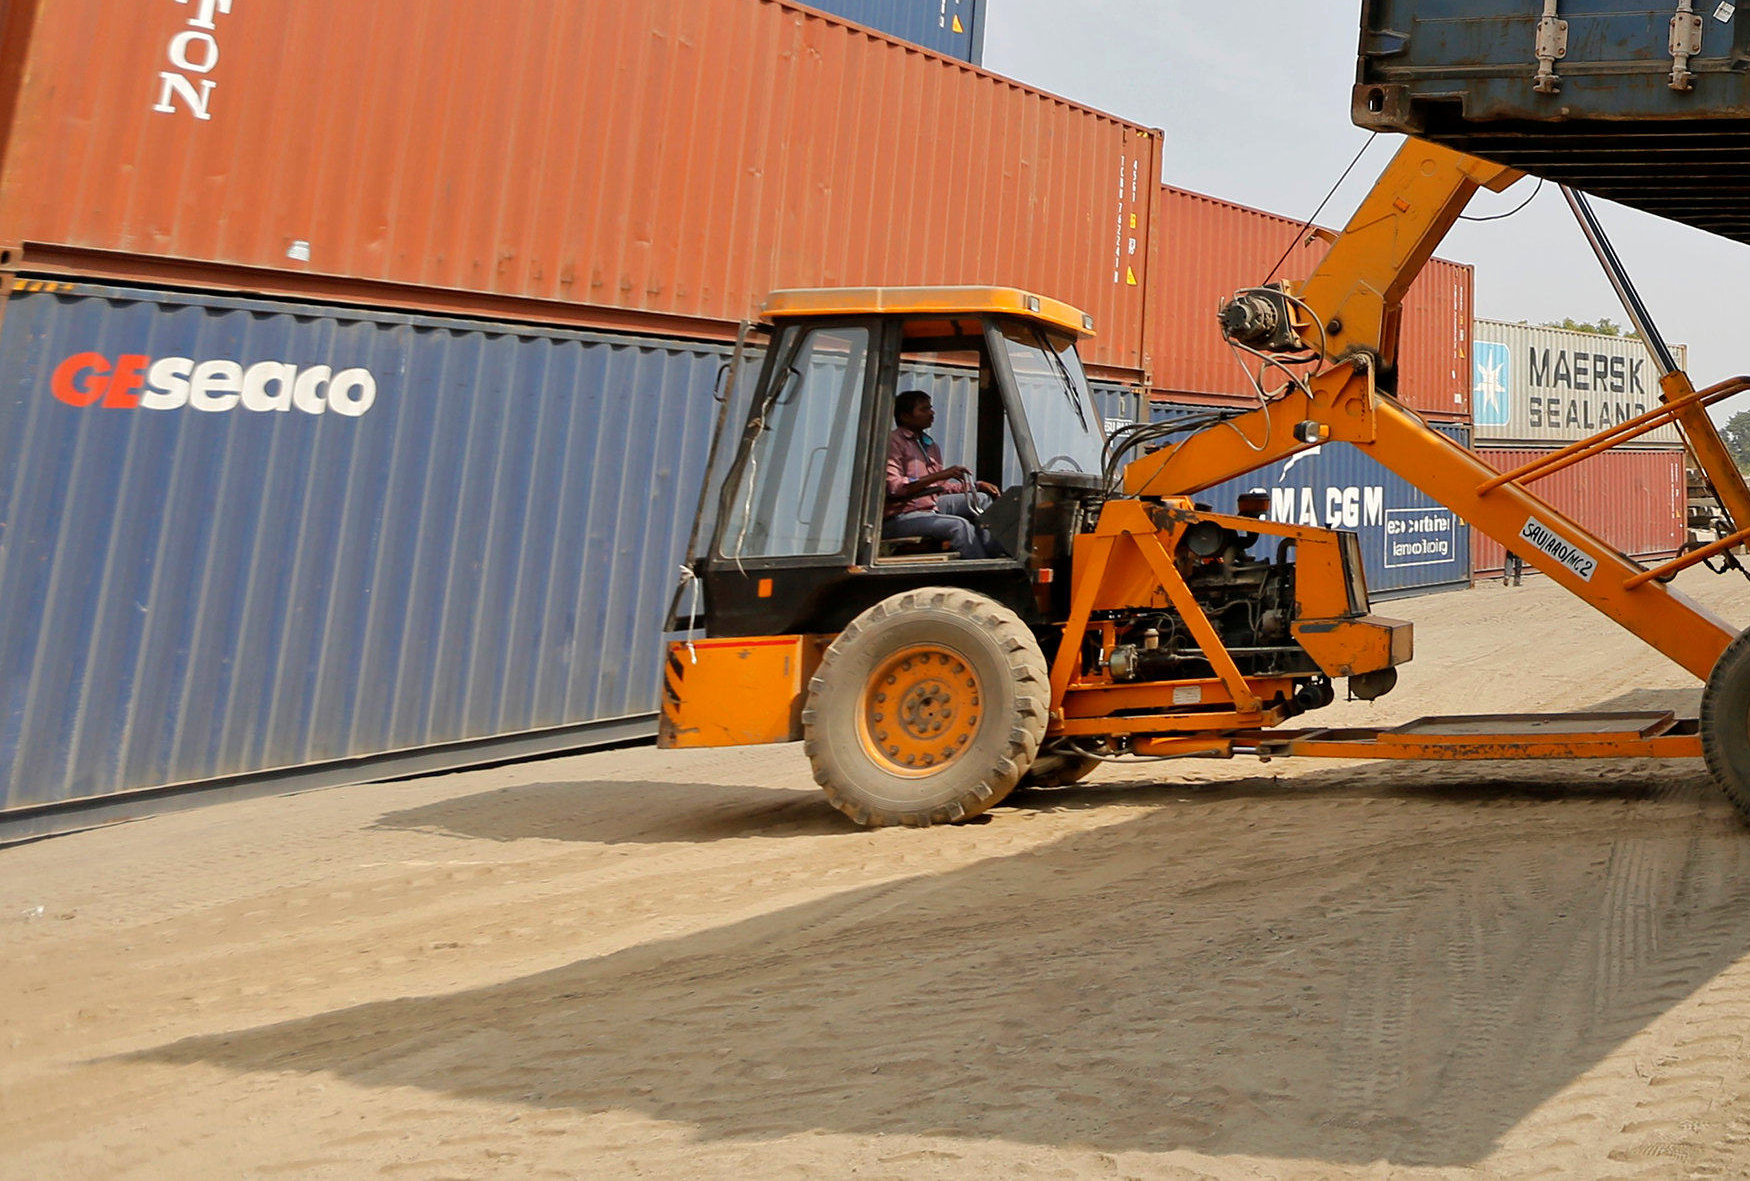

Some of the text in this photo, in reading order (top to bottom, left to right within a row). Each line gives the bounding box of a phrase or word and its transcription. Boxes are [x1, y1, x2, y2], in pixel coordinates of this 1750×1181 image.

[50, 351, 376, 417] GEseaco
[1529, 346, 1646, 395] MAERSK
[1326, 485, 1383, 529] CGM
